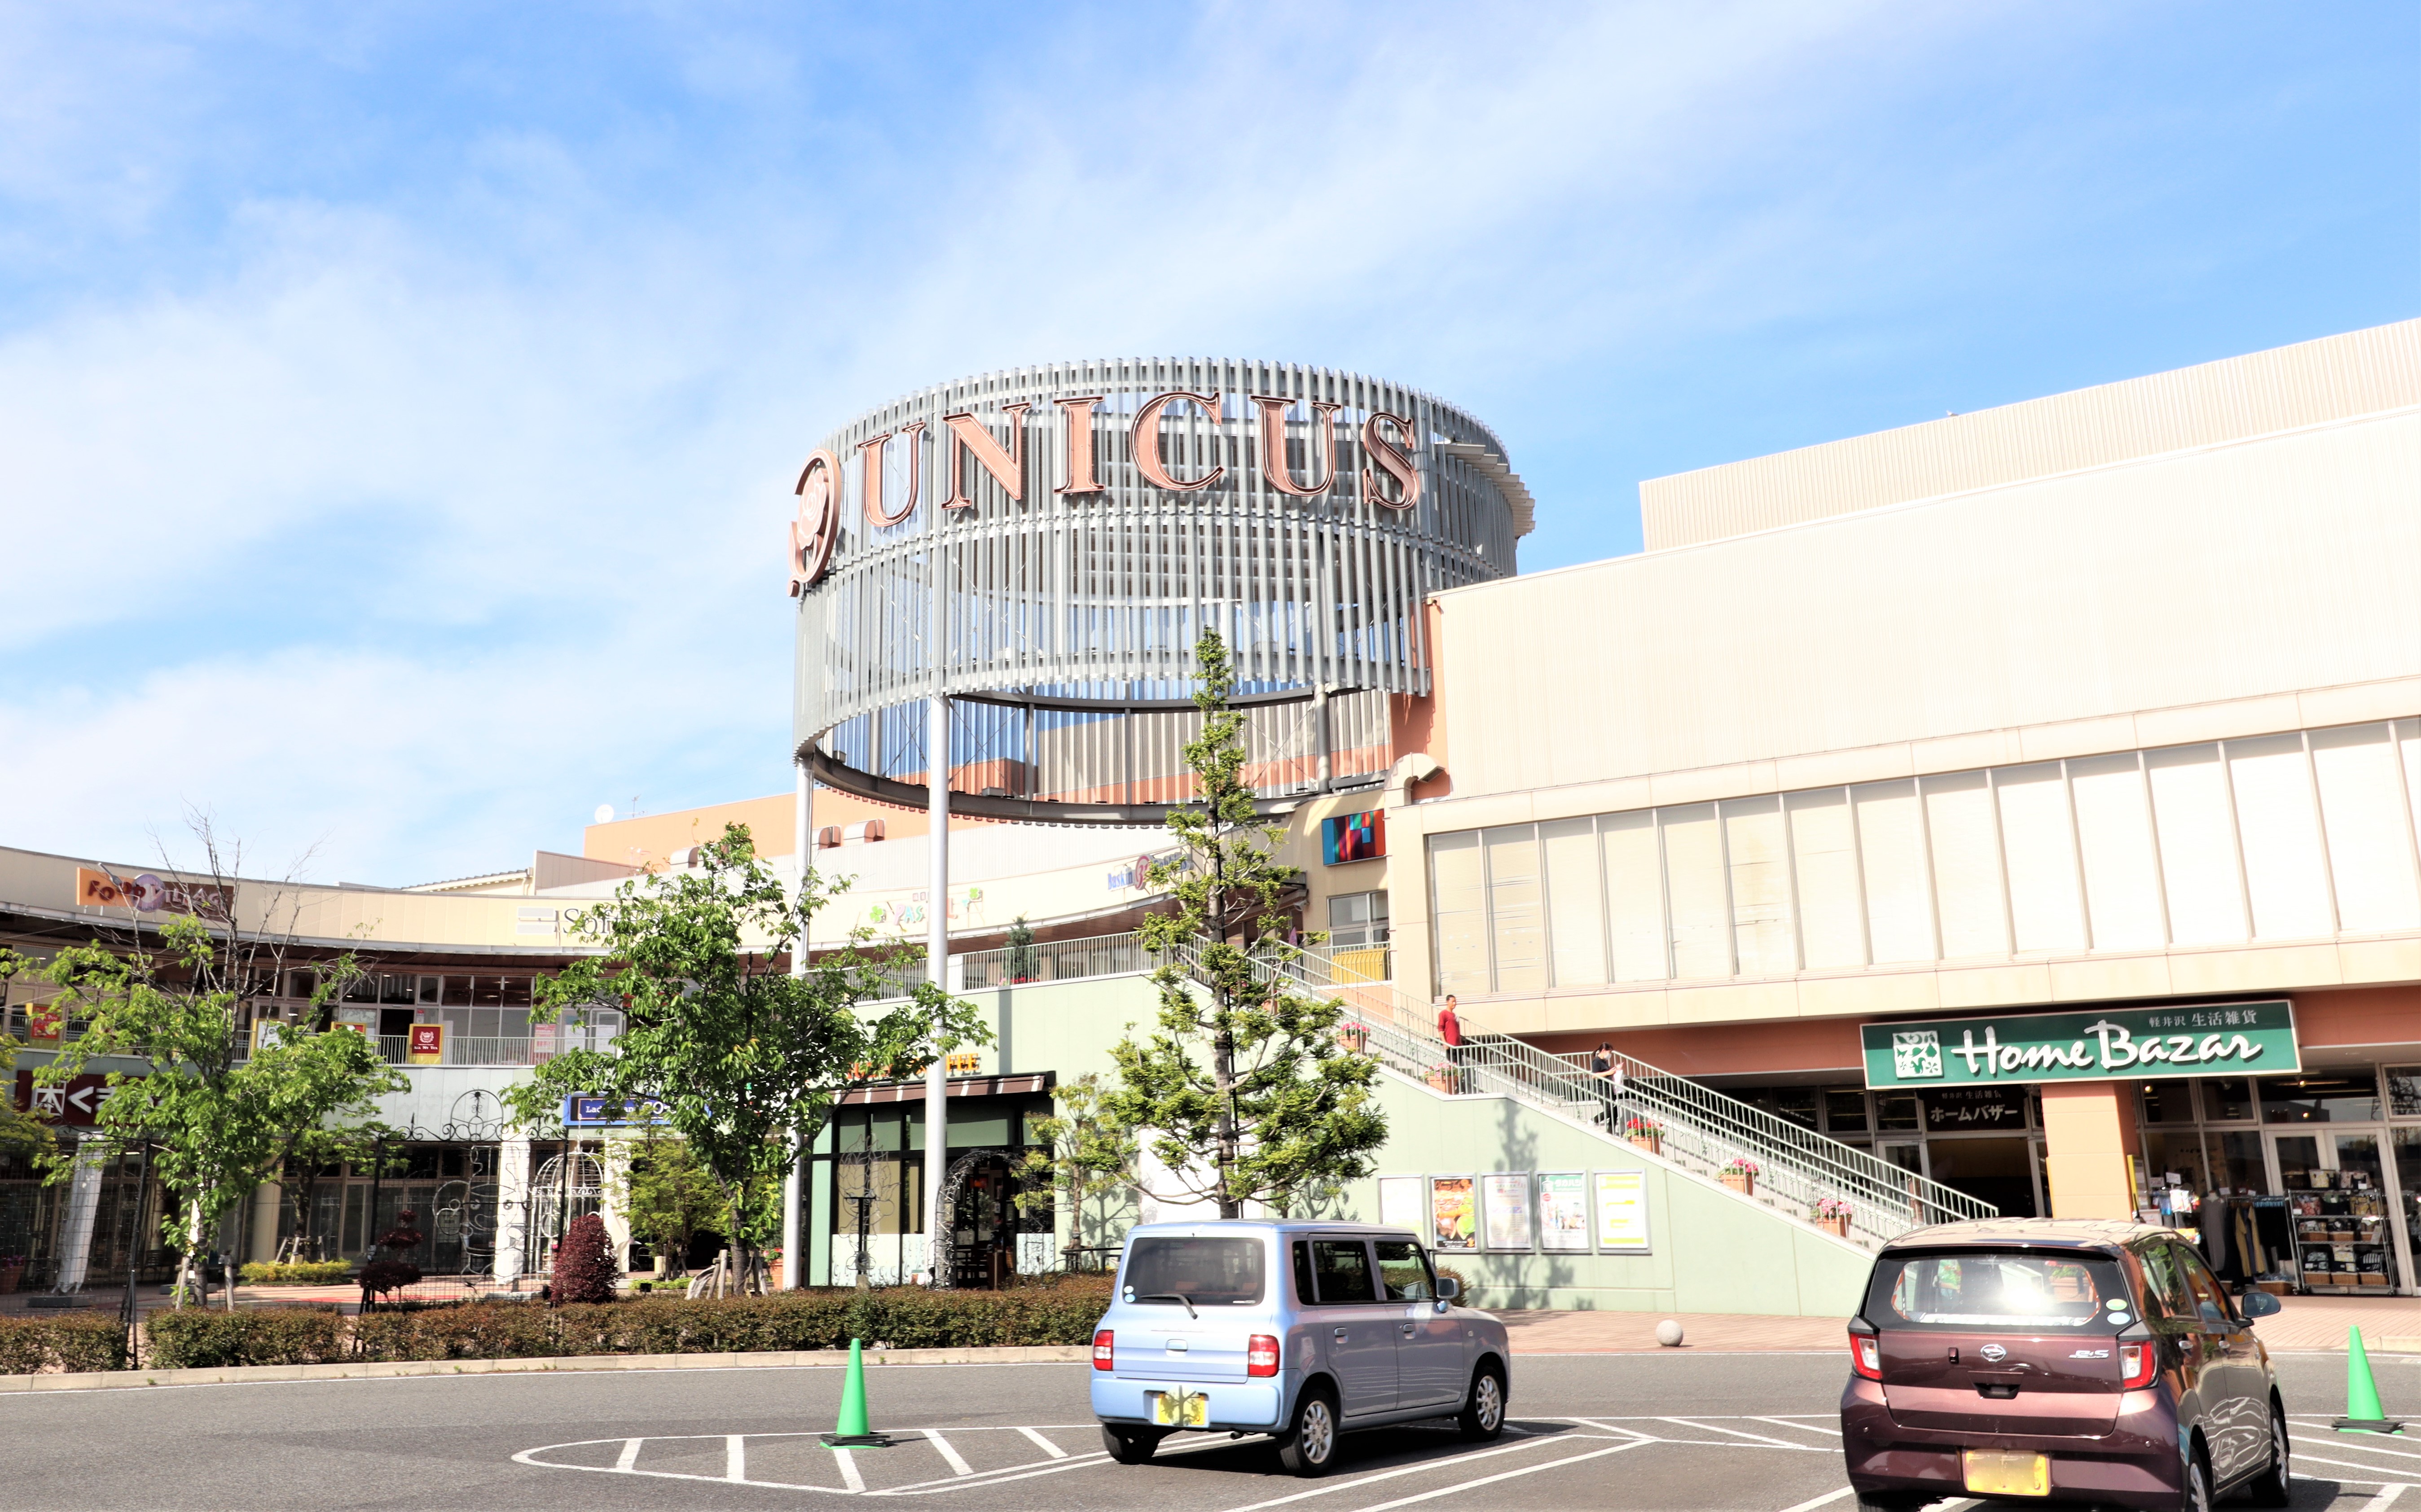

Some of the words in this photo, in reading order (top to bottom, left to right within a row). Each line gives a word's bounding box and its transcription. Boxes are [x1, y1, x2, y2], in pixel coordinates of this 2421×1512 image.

[857, 391, 1421, 527] UNICUS
[1107, 867, 1133, 890] Baskin
[88, 880, 145, 901] FOOD
[2149, 1015, 2186, 1028] 軽井沢
[2192, 1009, 2257, 1027] 生活雑貨
[1951, 1026, 2094, 1074] Home
[2084, 1020, 2262, 1069] Bazar
[1931, 1104, 2018, 1122] ホームバザー
